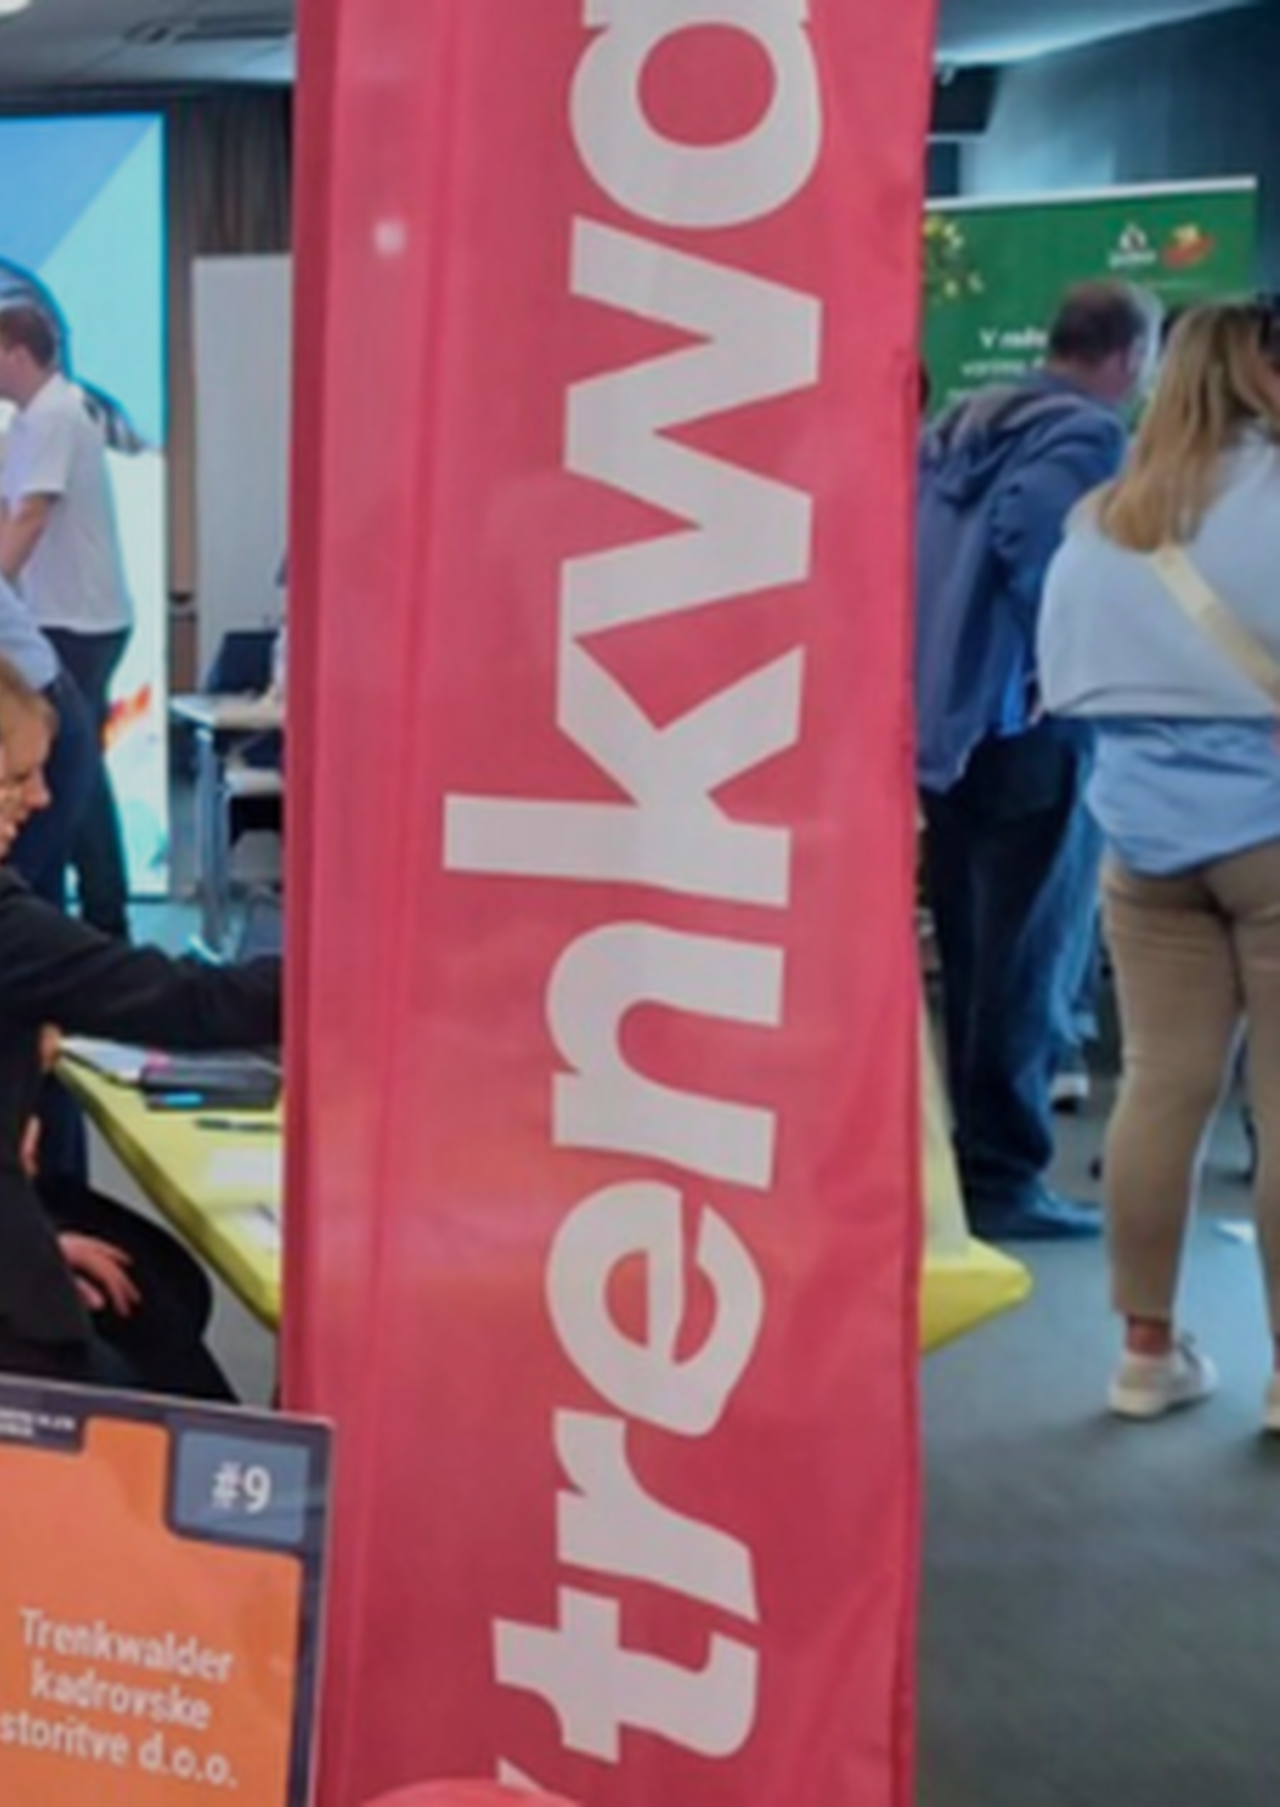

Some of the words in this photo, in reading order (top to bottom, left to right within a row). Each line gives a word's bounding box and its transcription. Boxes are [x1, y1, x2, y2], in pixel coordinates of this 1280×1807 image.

[443, 0, 824, 1764] trenkwa
[211, 1460, 271, 1514] #9
[18, 1606, 234, 1683] Trenkwalder
[30, 1655, 212, 1731] kadrovske
[138, 1731, 238, 1790] d.o.o.
